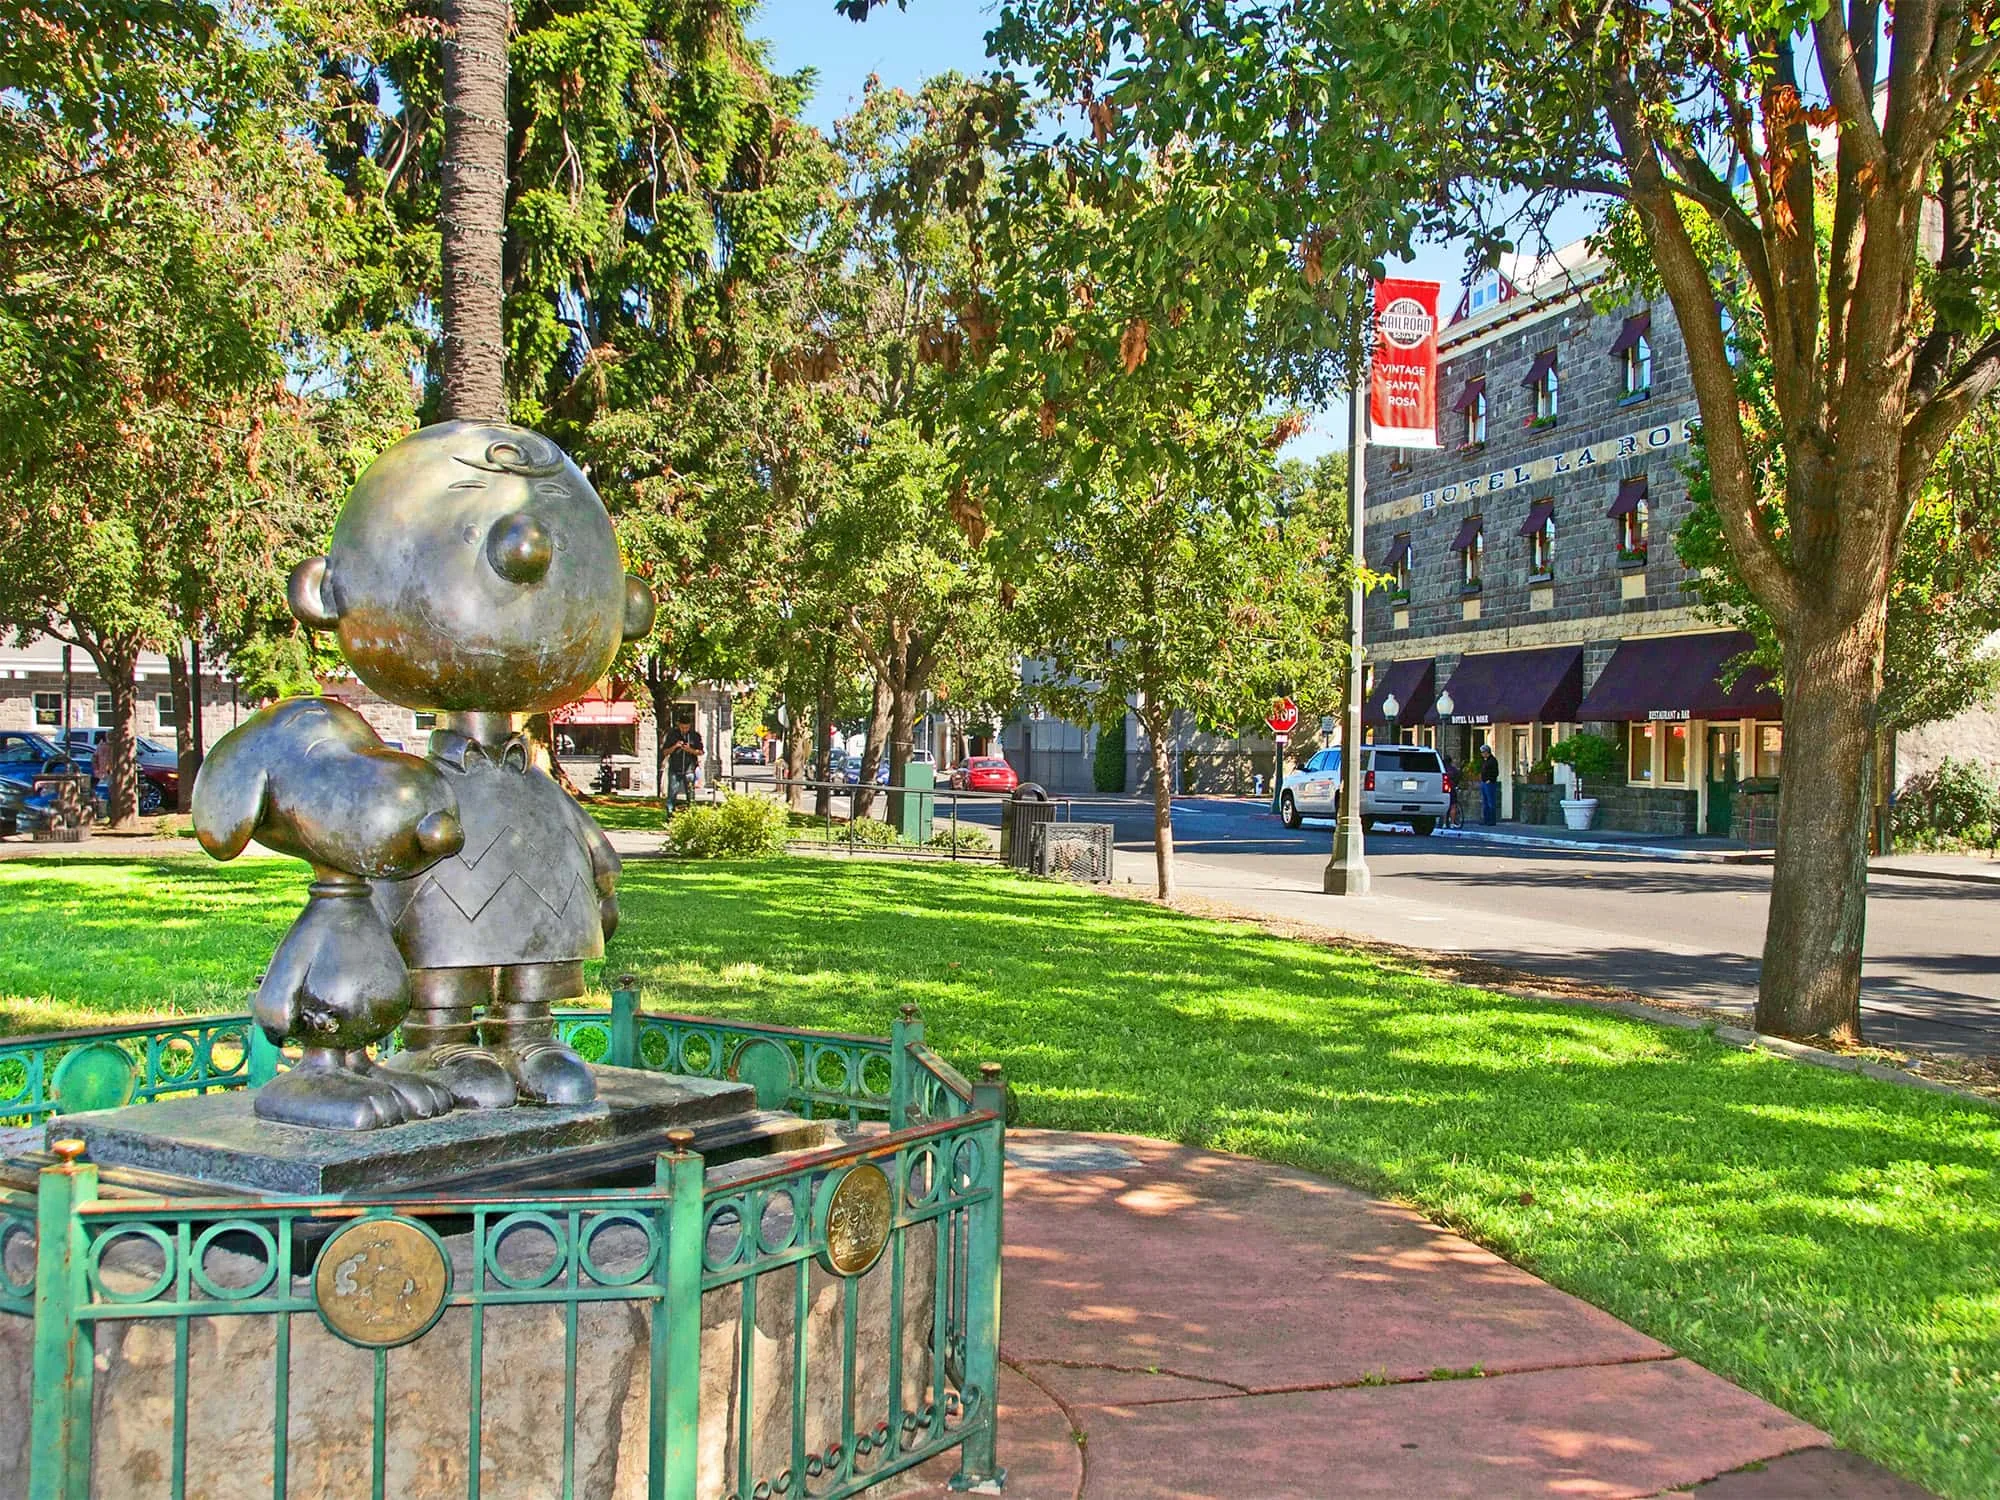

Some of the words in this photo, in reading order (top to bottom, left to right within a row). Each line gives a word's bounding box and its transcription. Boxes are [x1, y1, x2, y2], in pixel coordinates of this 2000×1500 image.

[1381, 315, 1430, 332] RAILROAD
[1381, 364, 1426, 376] VINTAGE
[1385, 381, 1420, 391] SANTA
[1388, 396, 1417, 407] ROSA
[1423, 466, 1531, 510] HOTEL
[1554, 447, 1596, 475] LA
